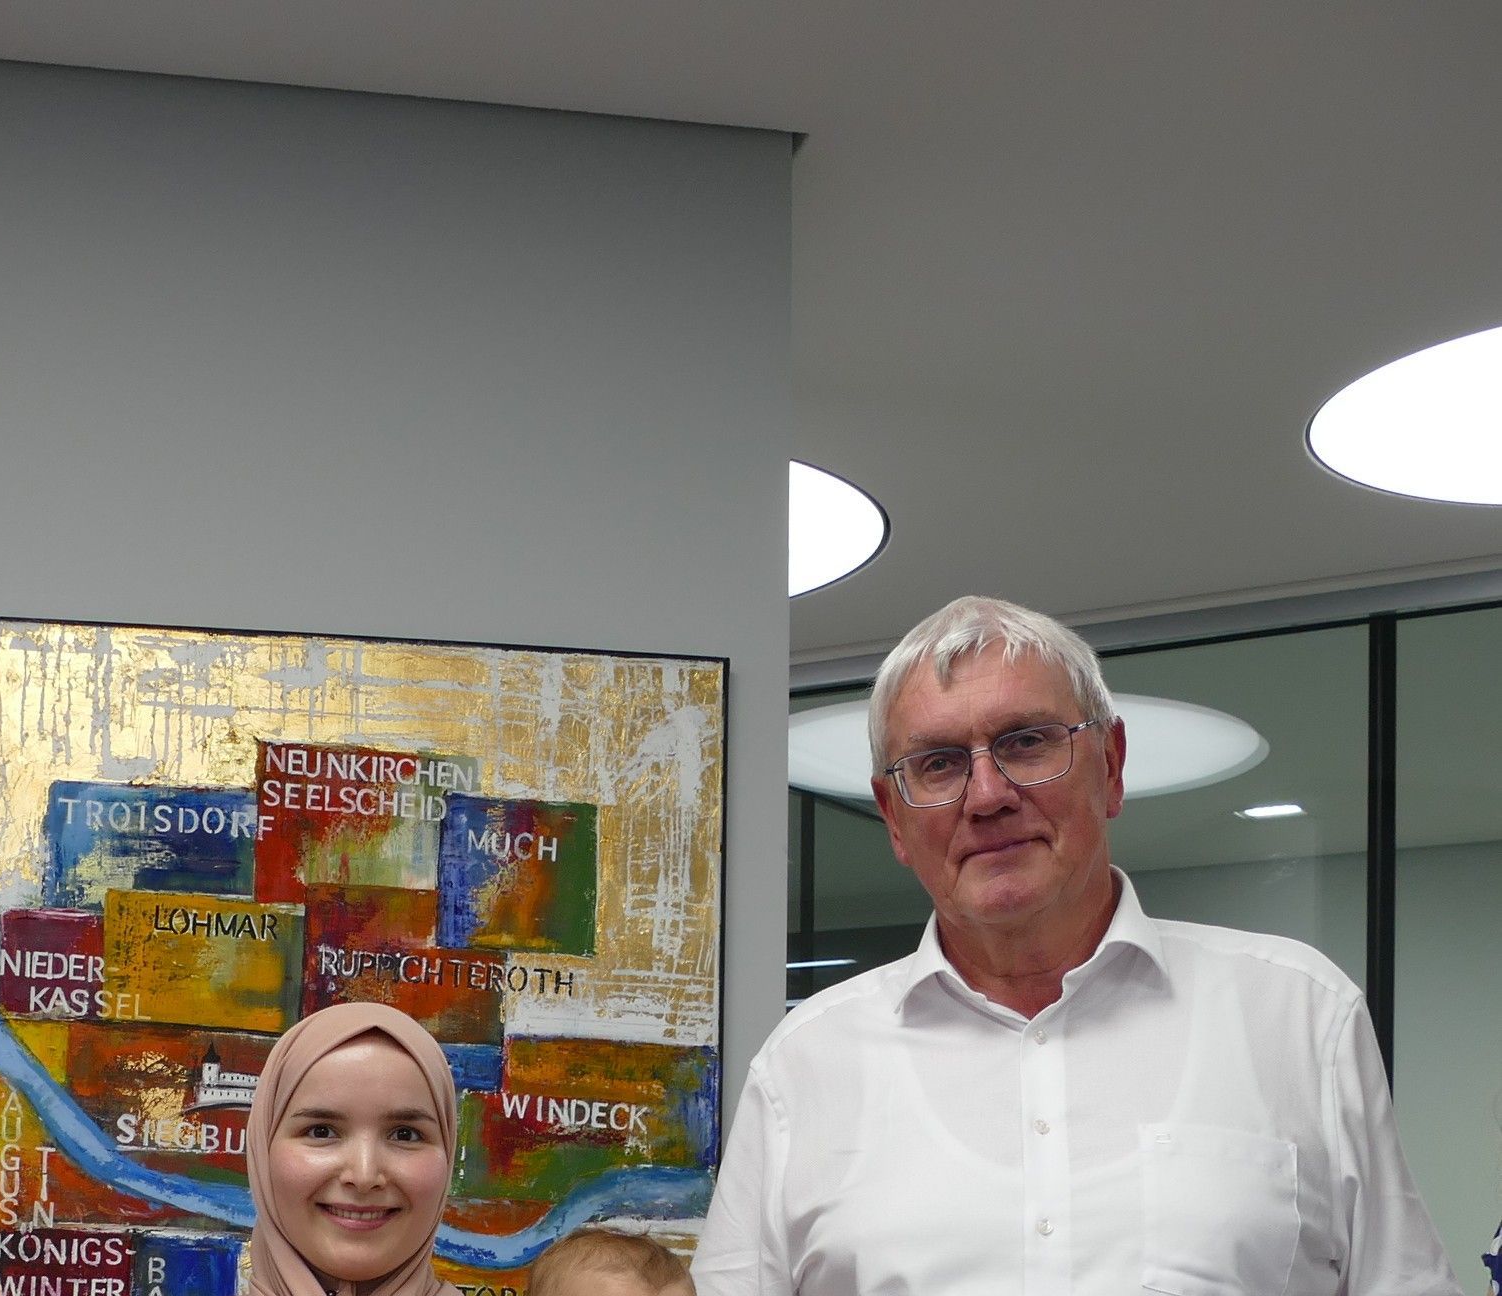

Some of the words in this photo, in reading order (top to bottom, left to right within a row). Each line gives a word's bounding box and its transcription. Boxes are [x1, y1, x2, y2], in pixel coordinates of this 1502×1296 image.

[265, 747, 473, 791] NEUNKIRCHEN
[59, 798, 274, 841] TROISDORF
[263, 780, 447, 822] SEELSCHEID
[467, 829, 558, 862] MUCH
[154, 905, 279, 941] LOHMAR
[318, 944, 574, 997] RUPPICHTEROTH
[29, 986, 151, 1021] KASSEL
[502, 1092, 649, 1132] WINDECK
[116, 1113, 246, 1155] SIEGBU
